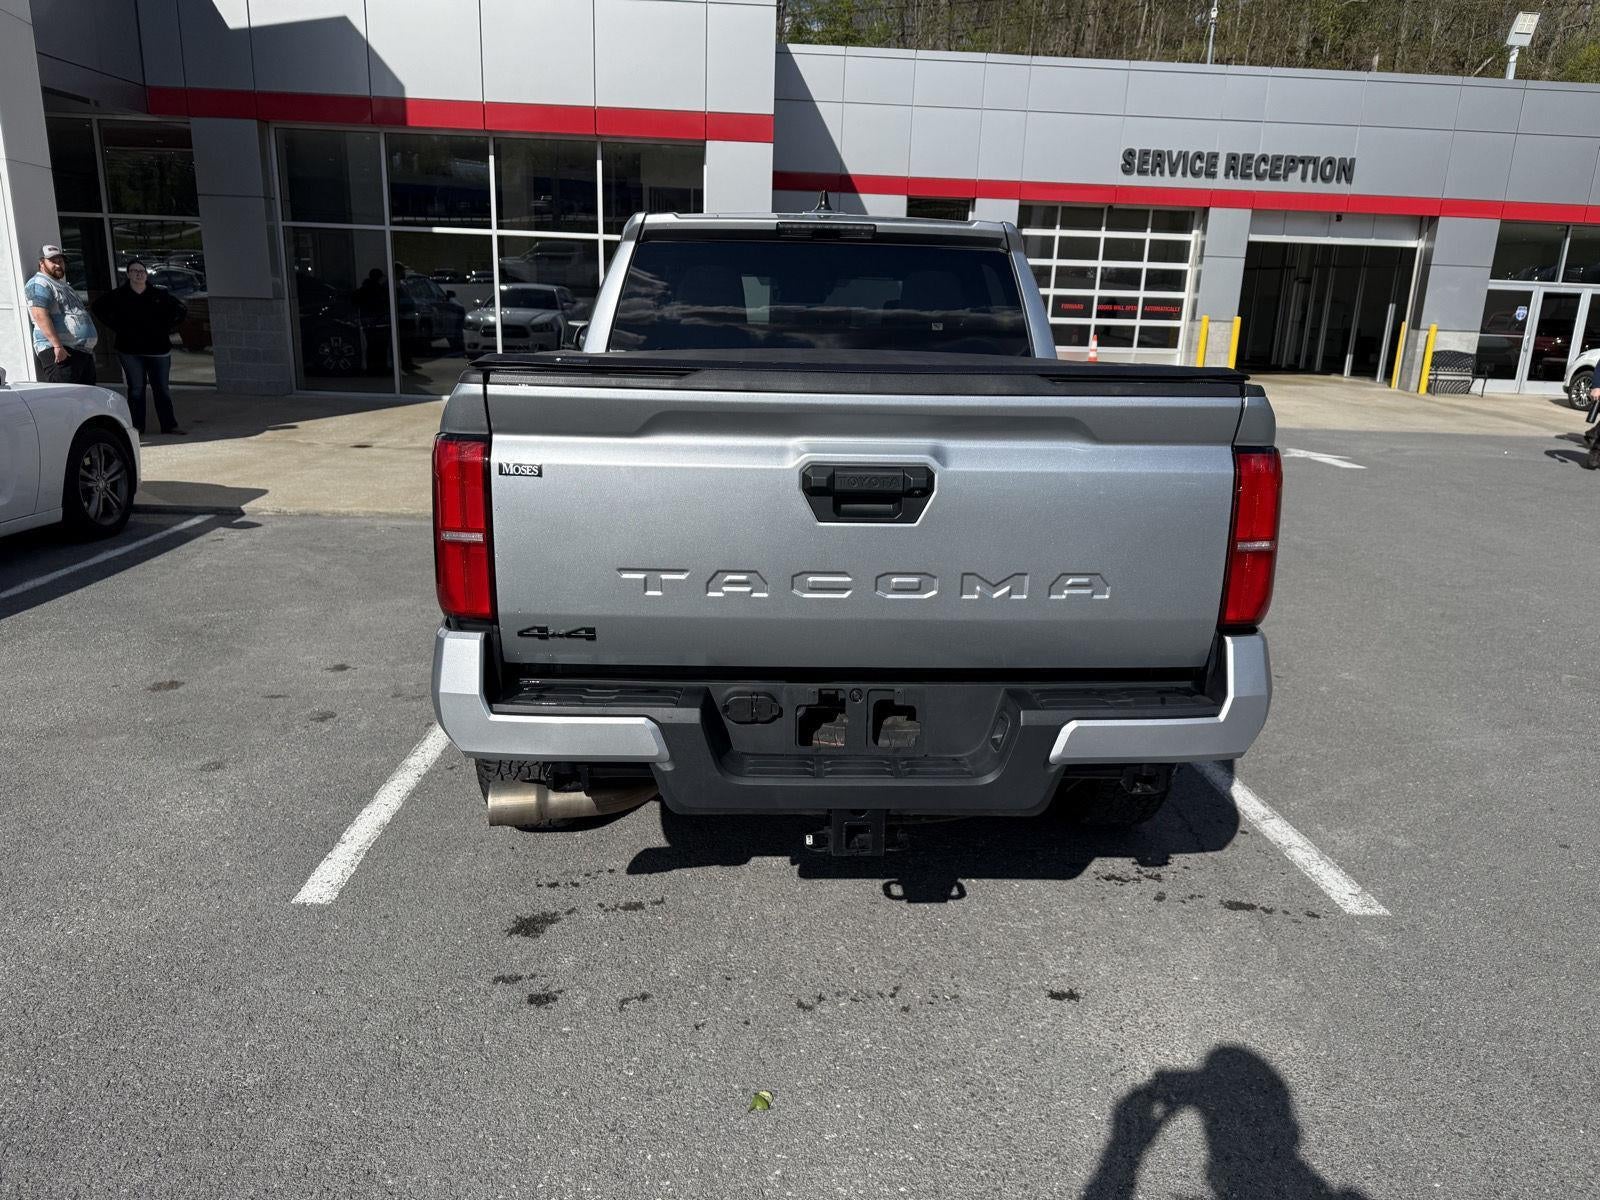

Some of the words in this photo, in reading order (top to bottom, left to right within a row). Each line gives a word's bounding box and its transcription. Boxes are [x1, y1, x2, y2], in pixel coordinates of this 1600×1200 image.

[1120, 148, 1219, 179] SERVICE
[1224, 152, 1356, 184] RECEPTION
[501, 462, 539, 476] MOSES
[838, 476, 902, 489] TOYOTA
[616, 568, 1111, 598] TACOMA
